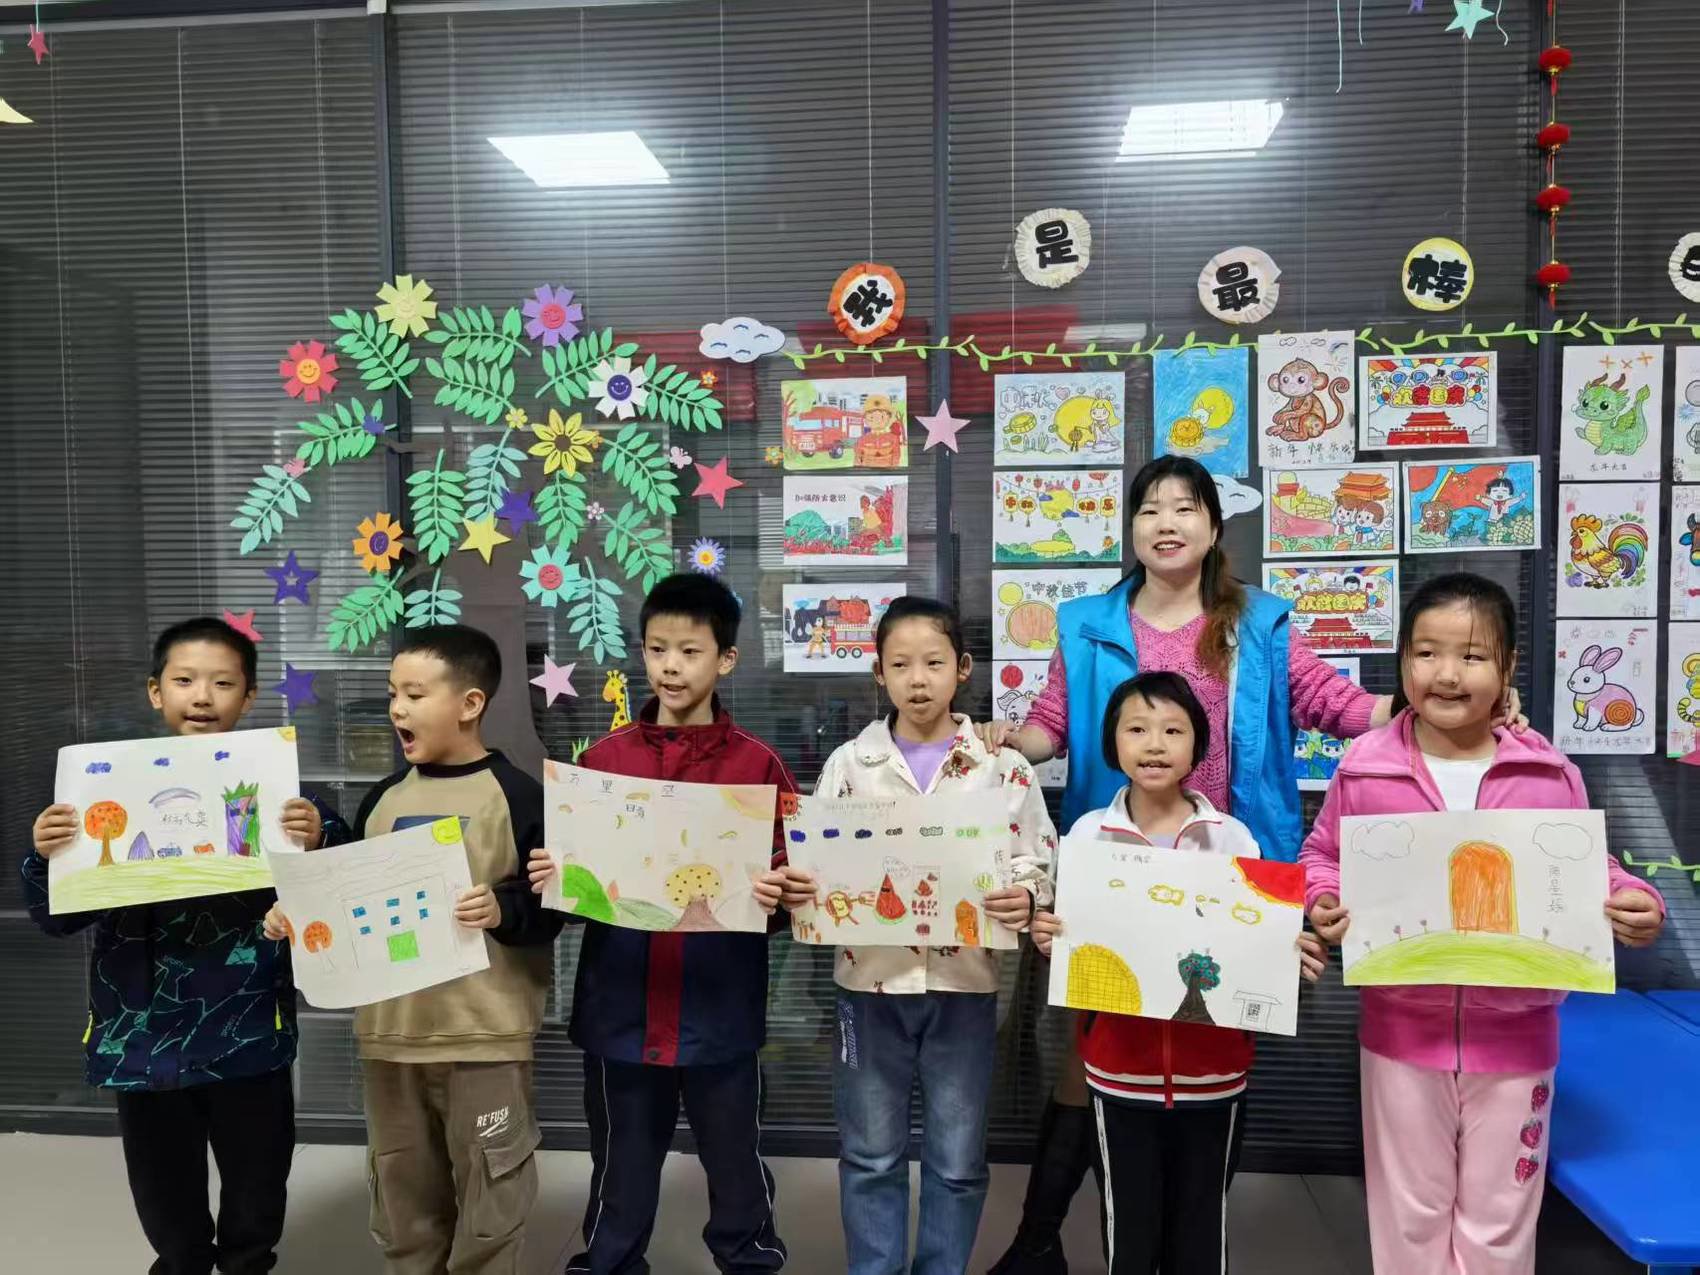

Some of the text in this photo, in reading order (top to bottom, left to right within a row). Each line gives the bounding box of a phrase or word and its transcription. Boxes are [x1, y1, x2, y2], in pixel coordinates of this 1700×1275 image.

[1035, 219, 1079, 269] 是
[1212, 261, 1261, 312] 最
[1406, 253, 1468, 304] 棒
